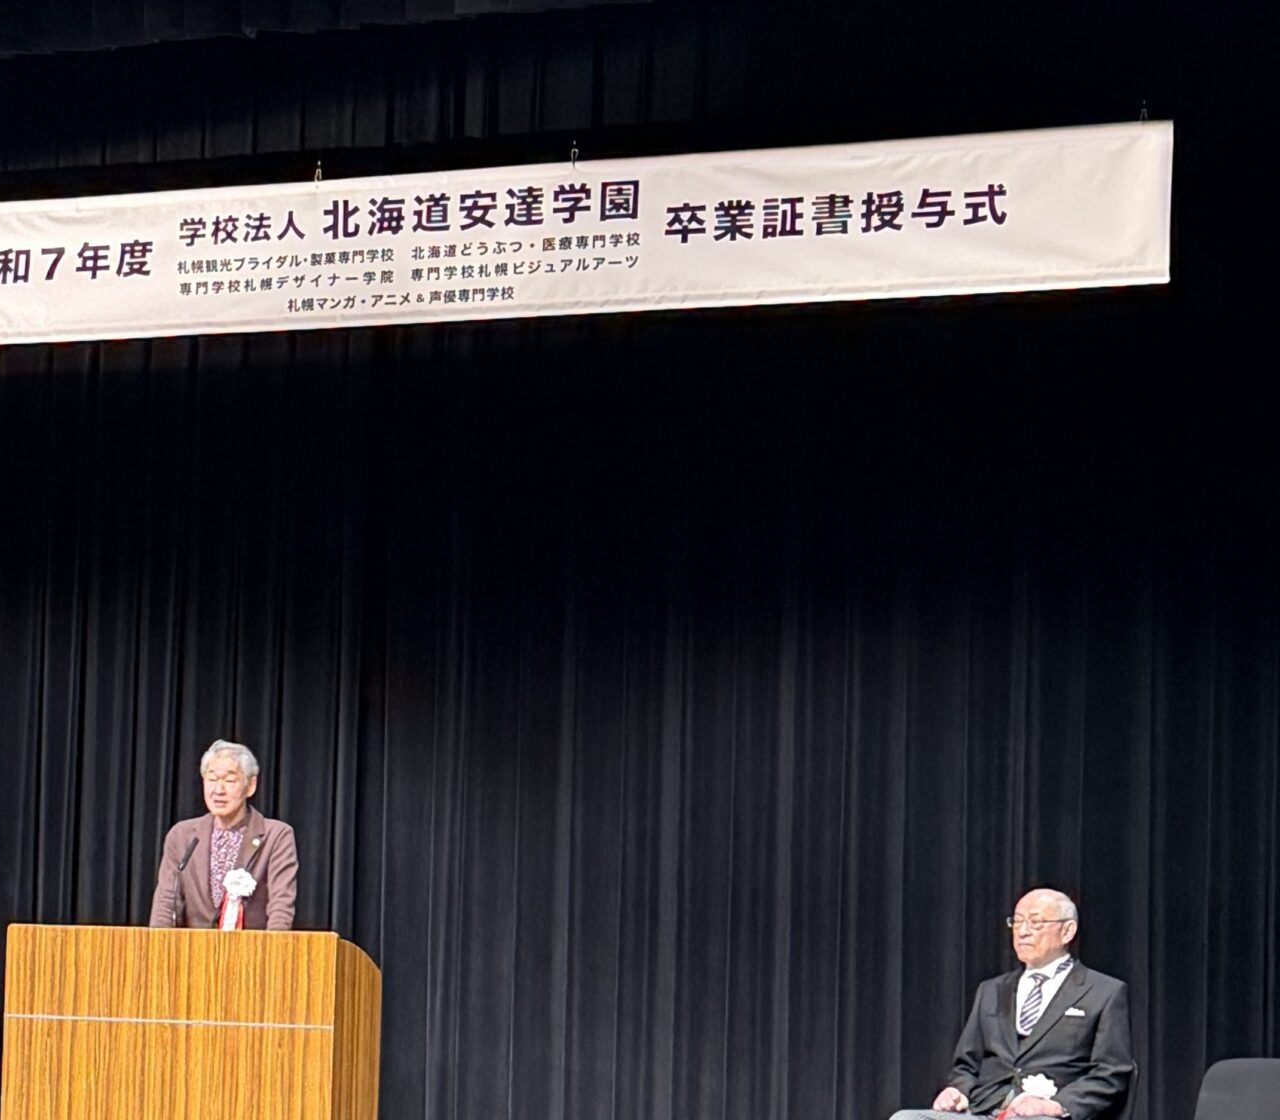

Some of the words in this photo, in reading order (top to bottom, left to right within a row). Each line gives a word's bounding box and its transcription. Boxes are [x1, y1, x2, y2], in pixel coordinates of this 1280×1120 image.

[178, 210, 306, 247] 学校法人
[322, 179, 640, 240] 北海道安達学園
[663, 183, 1010, 244] 卒業証書授与式
[176, 247, 395, 275] 札幌観光ブライダル・製菓専門学校
[411, 232, 641, 261] 北海道どうぶつ・医療専門学校
[179, 270, 394, 296] 専門学校札幌デザイナー学院
[410, 255, 639, 282] 専門学校札幌ビジュアルアーツ
